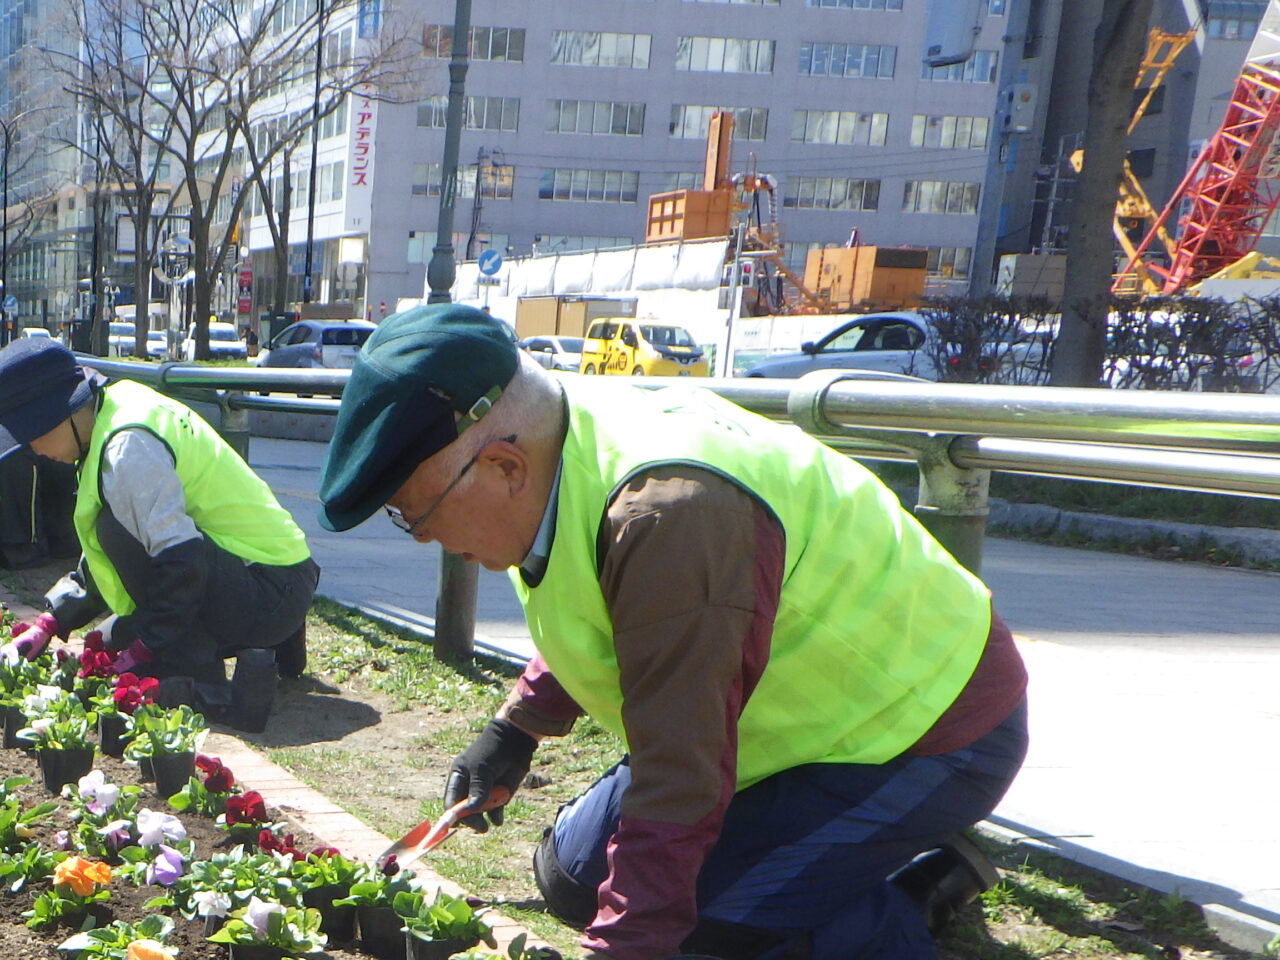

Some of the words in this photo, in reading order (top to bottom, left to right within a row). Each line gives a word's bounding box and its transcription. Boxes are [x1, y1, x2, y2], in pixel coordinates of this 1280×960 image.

[351, 112, 372, 186] アデランス
